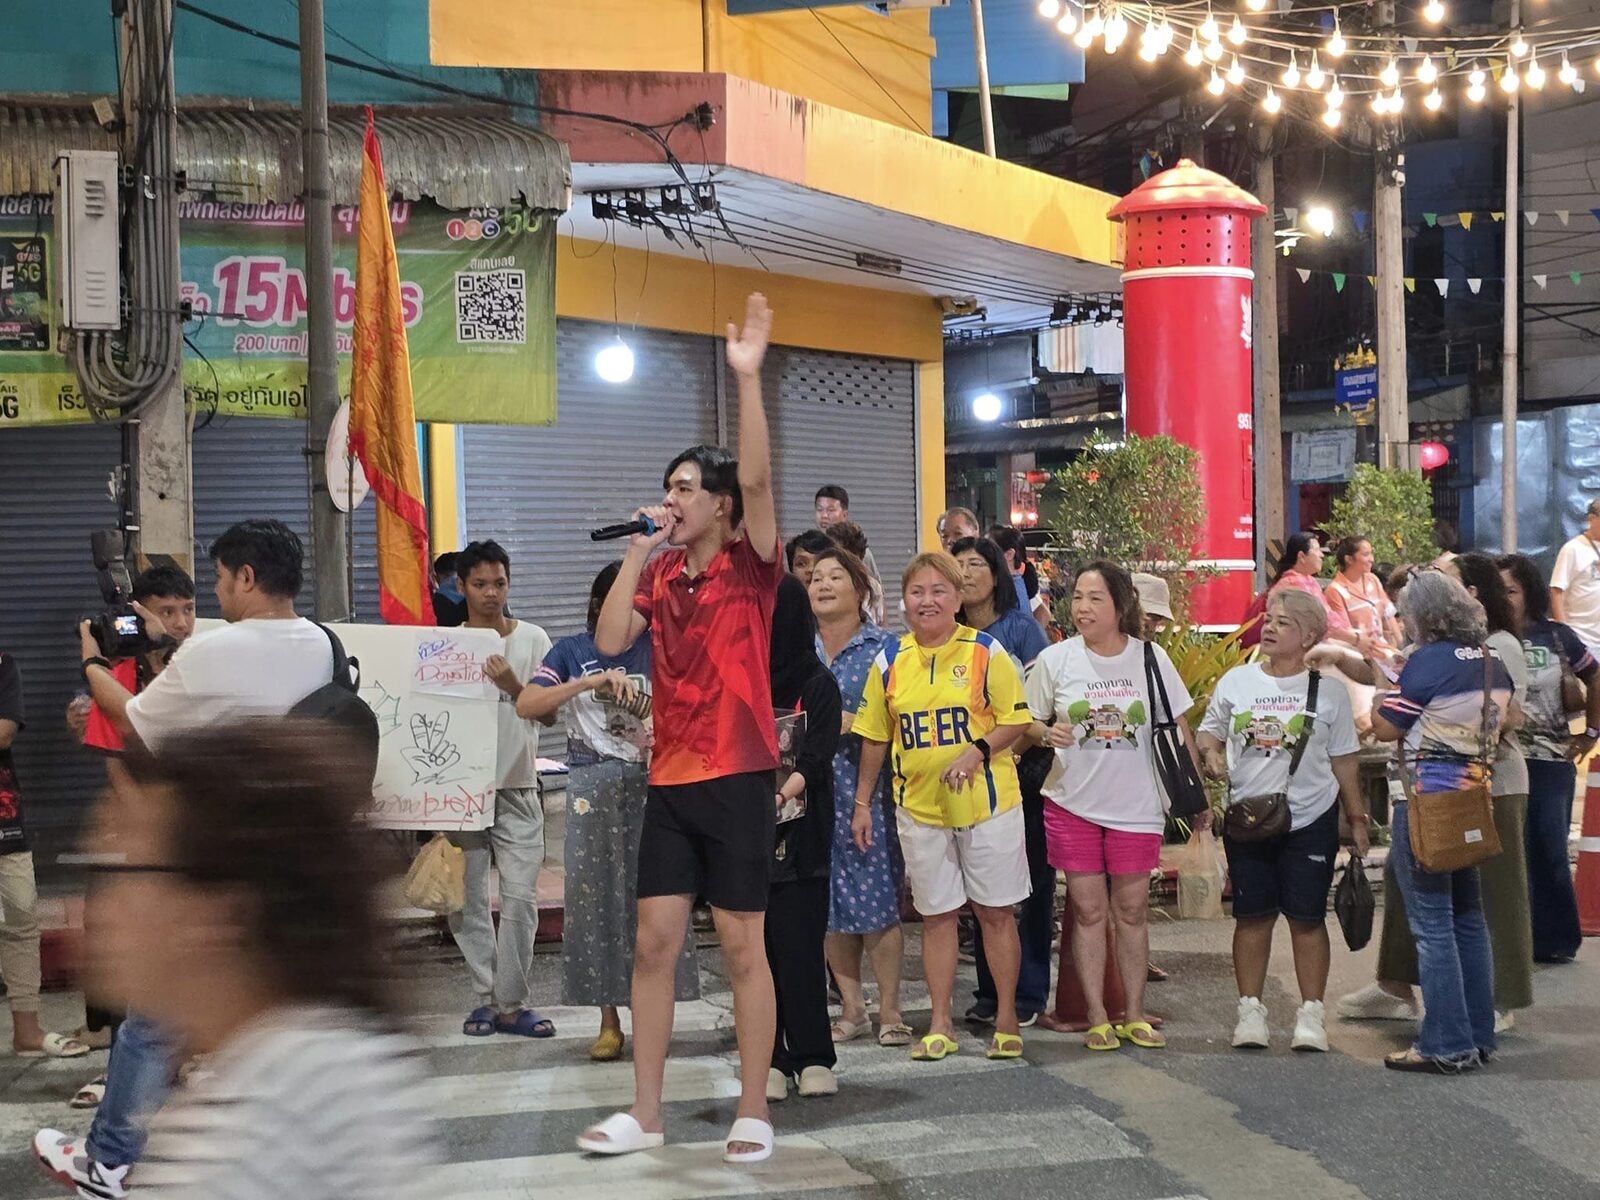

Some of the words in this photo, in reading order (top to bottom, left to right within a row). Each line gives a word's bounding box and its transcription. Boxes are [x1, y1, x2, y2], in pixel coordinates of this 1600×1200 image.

[236, 335, 265, 350] 200
[0, 385, 18, 394] AIS
[900, 706, 973, 751] BEER
